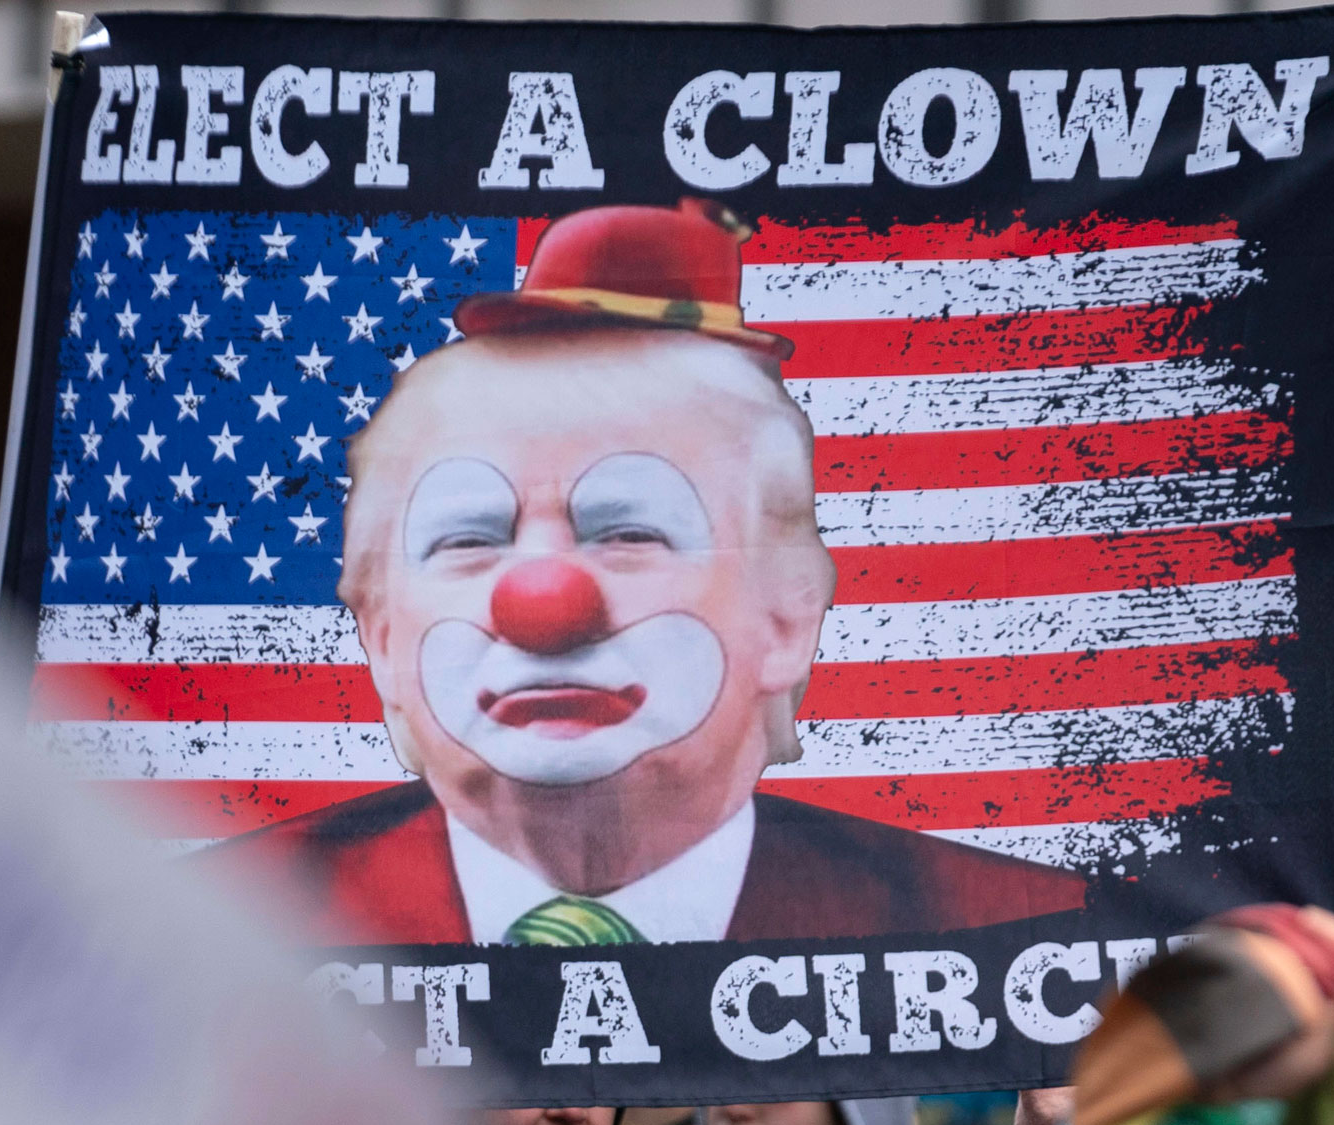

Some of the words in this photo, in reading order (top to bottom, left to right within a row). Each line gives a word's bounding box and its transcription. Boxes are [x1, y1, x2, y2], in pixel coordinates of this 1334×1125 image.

[80, 64, 435, 187] ELECT
[478, 71, 605, 190] A
[663, 55, 1330, 191] CLOWN
[541, 961, 661, 1066] A
[710, 934, 1215, 1064] CIRC
